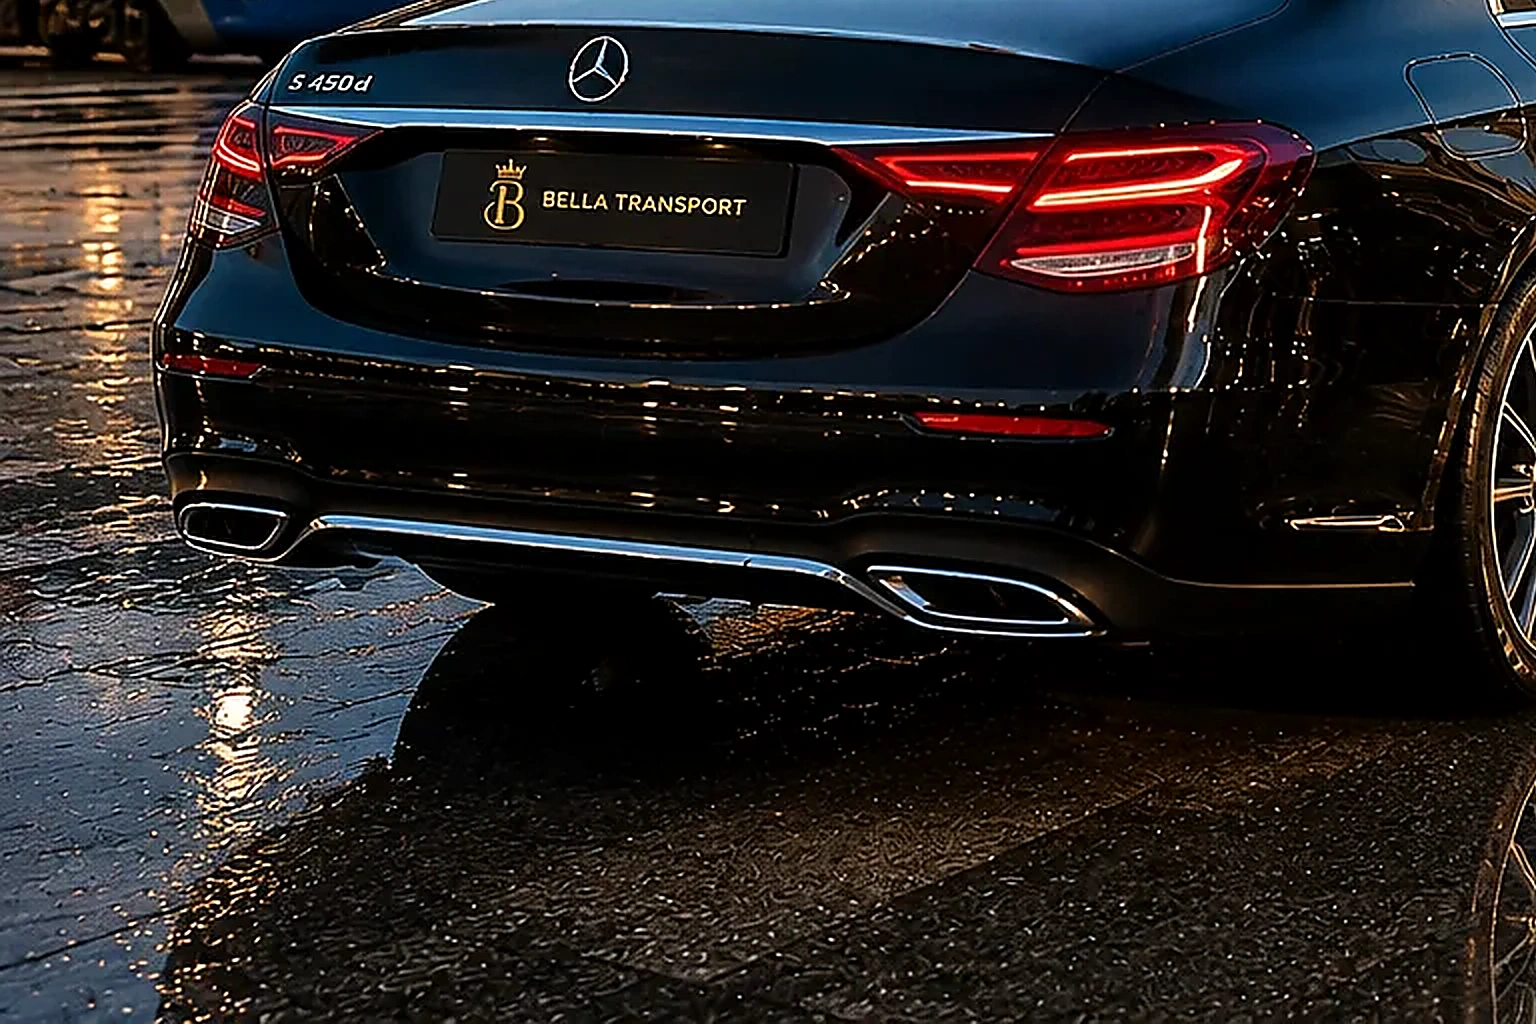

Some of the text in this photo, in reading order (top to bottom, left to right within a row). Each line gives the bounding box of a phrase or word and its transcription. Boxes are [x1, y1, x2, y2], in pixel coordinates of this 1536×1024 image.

[287, 73, 374, 93] S 450d
[483, 179, 525, 231] B
[542, 190, 748, 217] BELLA TRANSPORT
